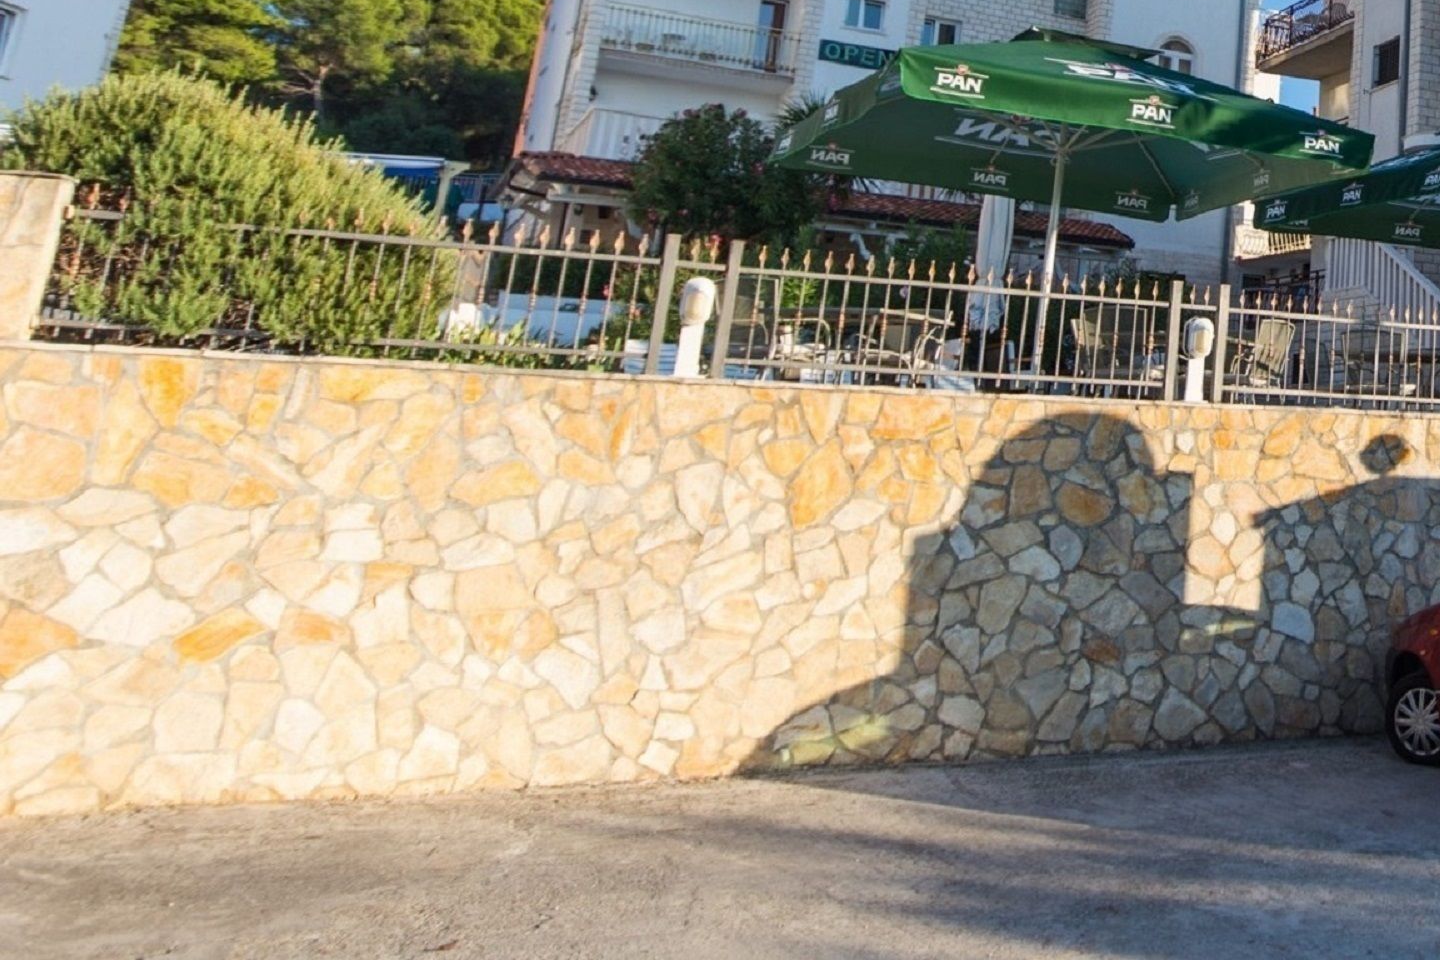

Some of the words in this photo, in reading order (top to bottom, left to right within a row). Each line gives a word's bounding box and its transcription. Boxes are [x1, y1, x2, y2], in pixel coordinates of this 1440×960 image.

[936, 72, 984, 94] PAN
[1132, 104, 1172, 123] PAN
[1304, 136, 1340, 154] PAN
[1342, 189, 1362, 203] PAN
[1266, 204, 1286, 219] PAN
